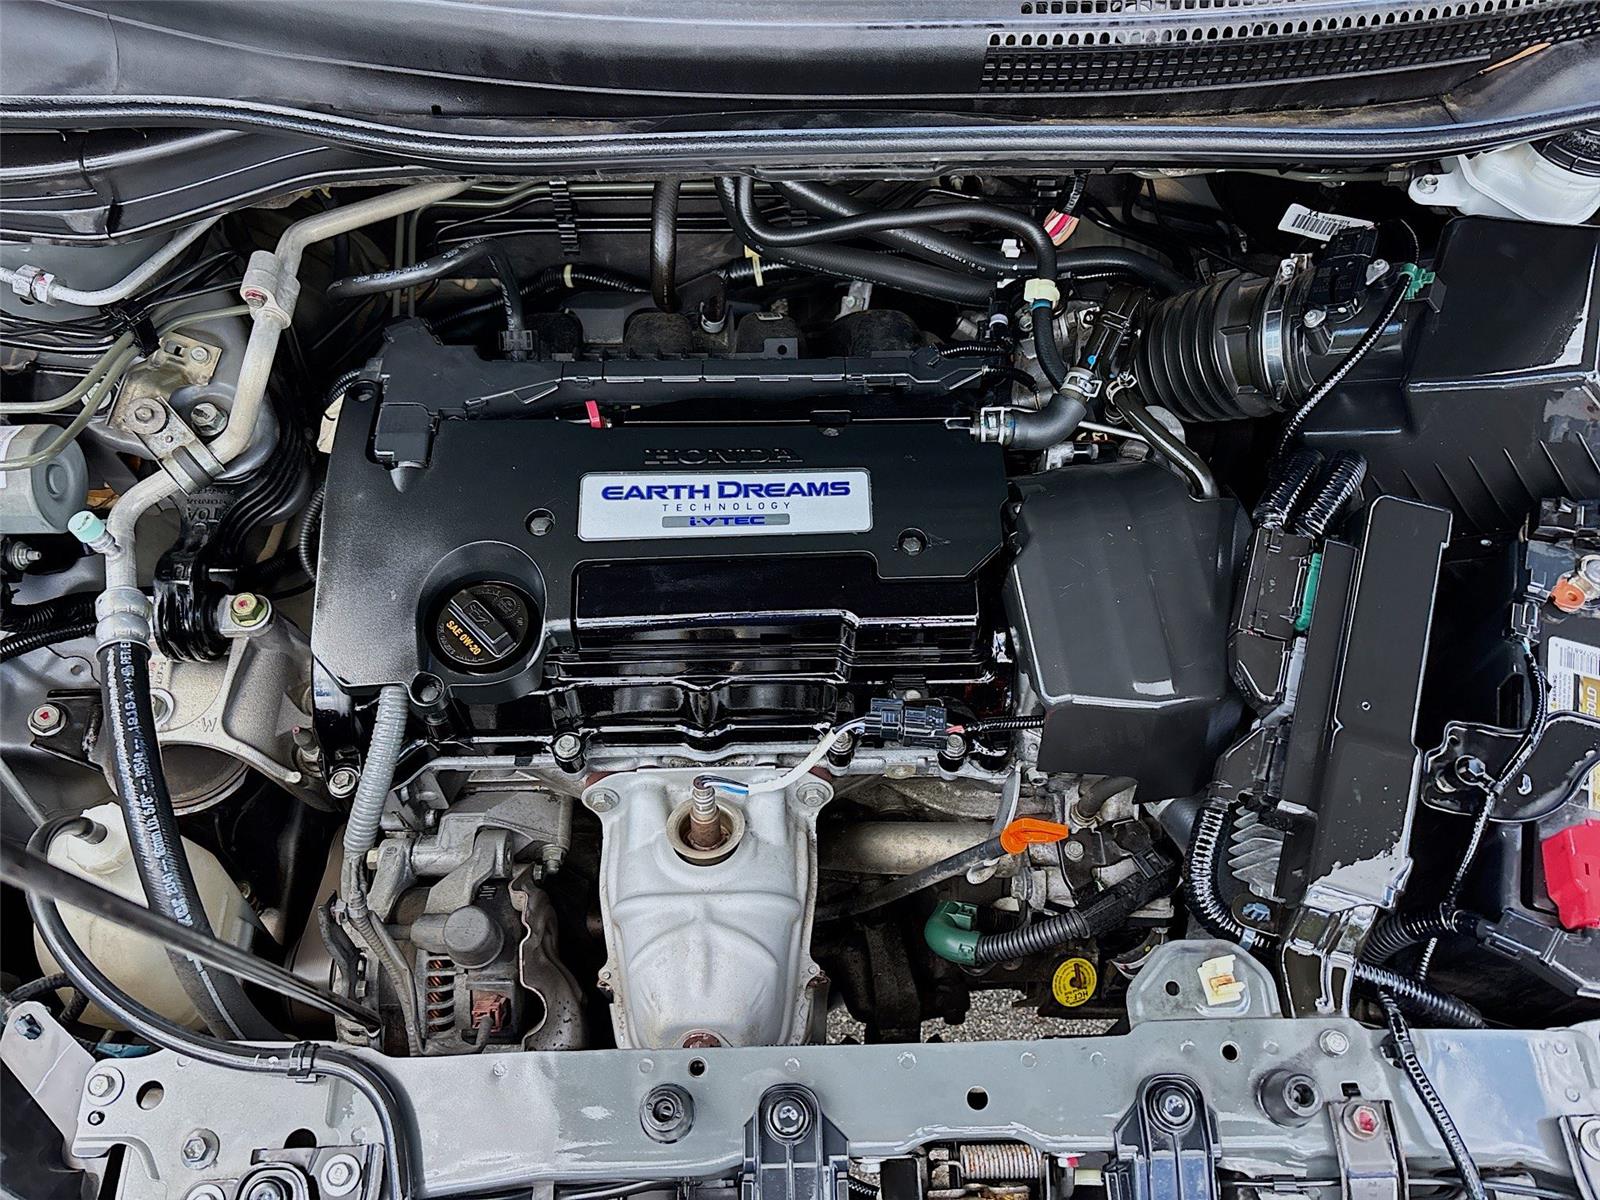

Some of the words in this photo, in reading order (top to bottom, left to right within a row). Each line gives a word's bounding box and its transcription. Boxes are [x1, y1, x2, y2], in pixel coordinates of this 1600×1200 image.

[644, 448, 804, 465] HONDA
[601, 484, 710, 500] EARTH
[717, 480, 851, 499] DREAMS
[662, 501, 791, 512] TECHNOLOGY
[689, 515, 766, 527] i-VTEC
[446, 619, 462, 637] SAE
[459, 632, 482, 655] 0W-20
[1065, 990, 1089, 1003] HCF-2
